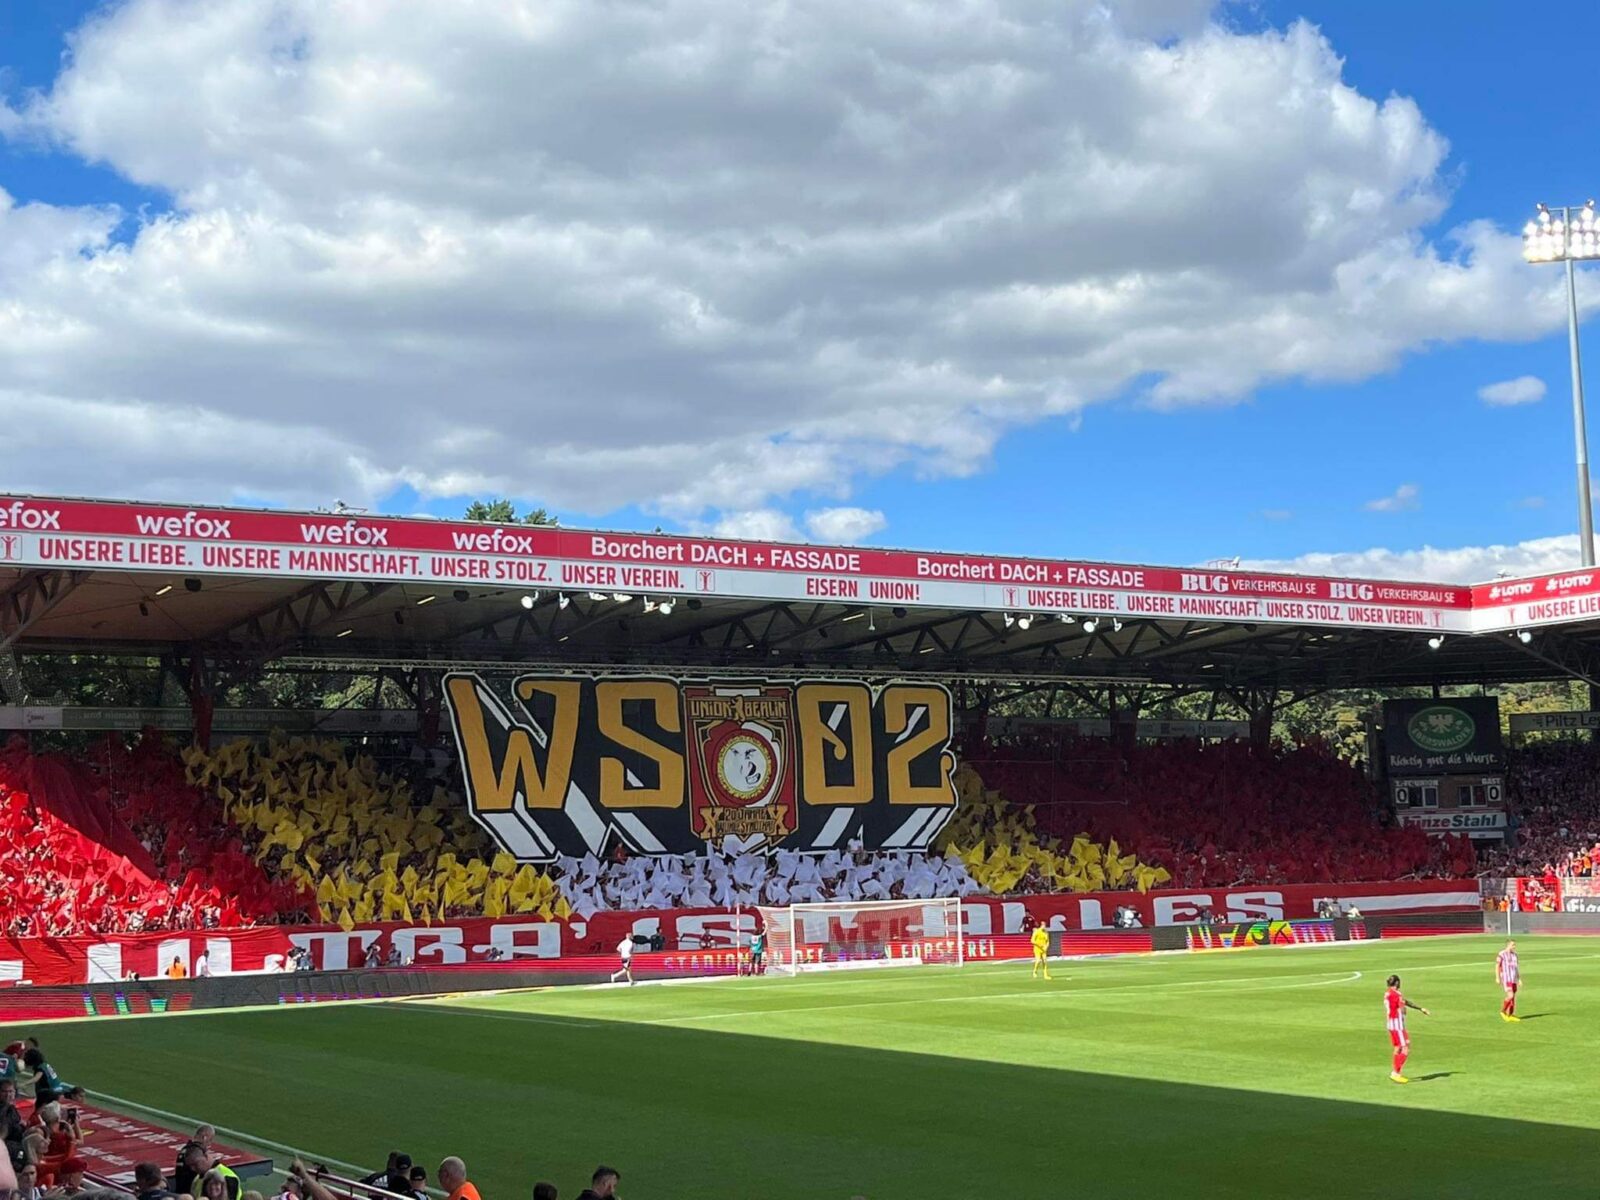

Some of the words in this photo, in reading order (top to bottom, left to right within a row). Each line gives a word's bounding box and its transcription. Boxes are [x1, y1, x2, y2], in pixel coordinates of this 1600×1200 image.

[136, 511, 231, 538] wefox
[301, 520, 388, 546] wefox
[452, 529, 533, 554] wefox
[38, 538, 124, 563] UNSERE
[129, 543, 193, 566] LIEBE.
[202, 546, 280, 569] UNSERE
[288, 550, 423, 576] MANNSCHAFT.
[431, 557, 490, 579] UNSER
[495, 561, 552, 582] STOLZ.
[562, 564, 616, 585] UNSER
[621, 567, 685, 589] VEREIN.
[591, 536, 684, 561] Borchert
[690, 544, 747, 566] DACH
[753, 552, 766, 566] +
[770, 549, 860, 572] FASSADE
[917, 557, 995, 579] Borchert
[1000, 563, 1048, 583] DACH
[1052, 571, 1063, 583] +
[1066, 567, 1145, 588] FASSADE
[1180, 573, 1229, 593] BUG
[1231, 578, 1303, 595] VERKEHRSBAU
[1305, 582, 1317, 595] SE
[1560, 575, 1593, 588] LOTTO
[806, 577, 858, 598] EISERN
[869, 581, 920, 601] UNION!
[1329, 581, 1374, 601] BUG
[1376, 587, 1442, 603] VERKEHRSBAU
[1443, 591, 1455, 604] SE
[1502, 583, 1533, 597] LOTTO
[1027, 589, 1078, 608] UNSERE
[1081, 592, 1120, 611] LIEBE.
[1127, 595, 1174, 614] UNSERE
[1179, 598, 1262, 618] MANNSCHAFT.
[1266, 603, 1304, 620] UNSER
[1307, 605, 1344, 622] STOLZ.
[1348, 607, 1384, 624] UNSER
[1385, 609, 1428, 627] VEREIN.
[1528, 600, 1576, 621] UNSERE
[1545, 714, 1577, 729] Piltz
[449, 678, 684, 810] WS
[797, 684, 956, 805] 02
[1411, 728, 1474, 747] EBERSWALDER
[1390, 755, 1423, 769] Richtig
[1427, 755, 1444, 768] gut
[1448, 753, 1462, 765] die
[1397, 788, 1407, 803] 0
[1489, 785, 1499, 801] 0
